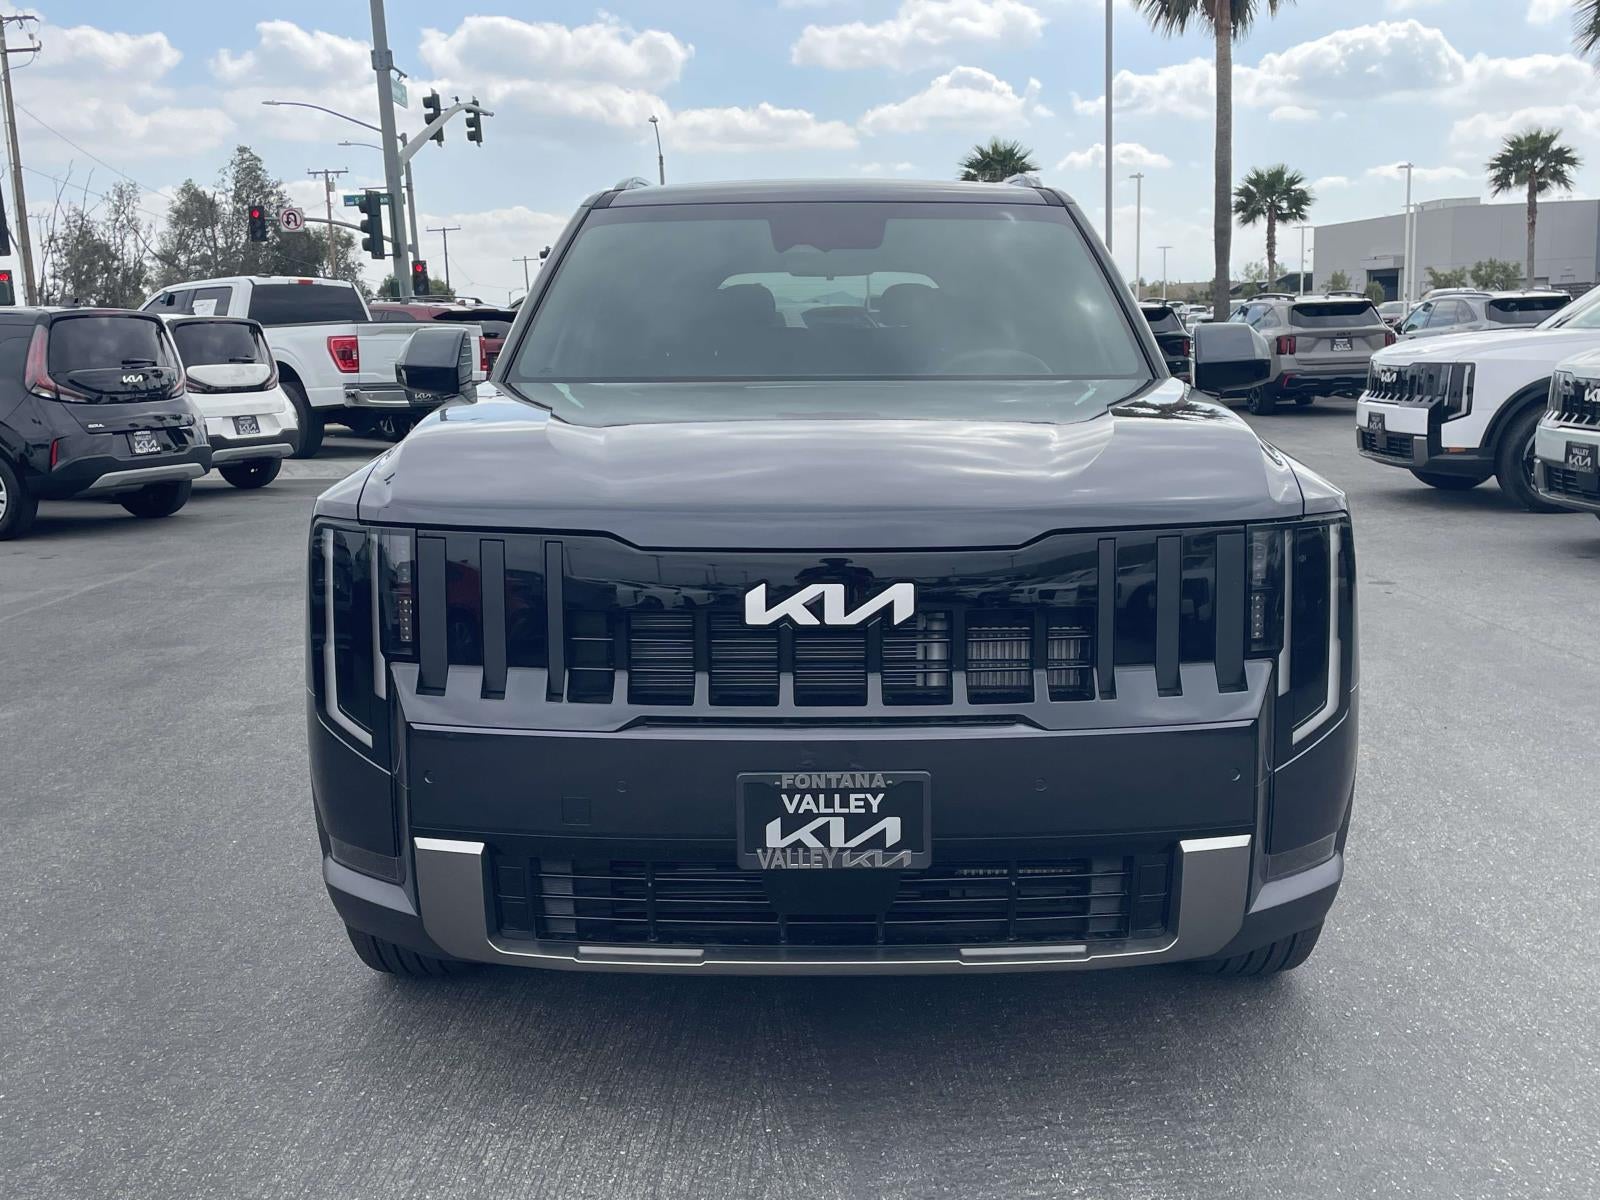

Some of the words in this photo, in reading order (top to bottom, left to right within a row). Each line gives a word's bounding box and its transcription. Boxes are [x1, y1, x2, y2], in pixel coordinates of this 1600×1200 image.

[122, 374, 143, 383] KIA
[1568, 454, 1592, 467] KIA
[745, 583, 914, 625] KIA
[781, 794, 885, 814] VALLEY
[766, 817, 901, 849] KIA
[757, 848, 839, 869] VALLEY
[842, 850, 912, 868] KIA
